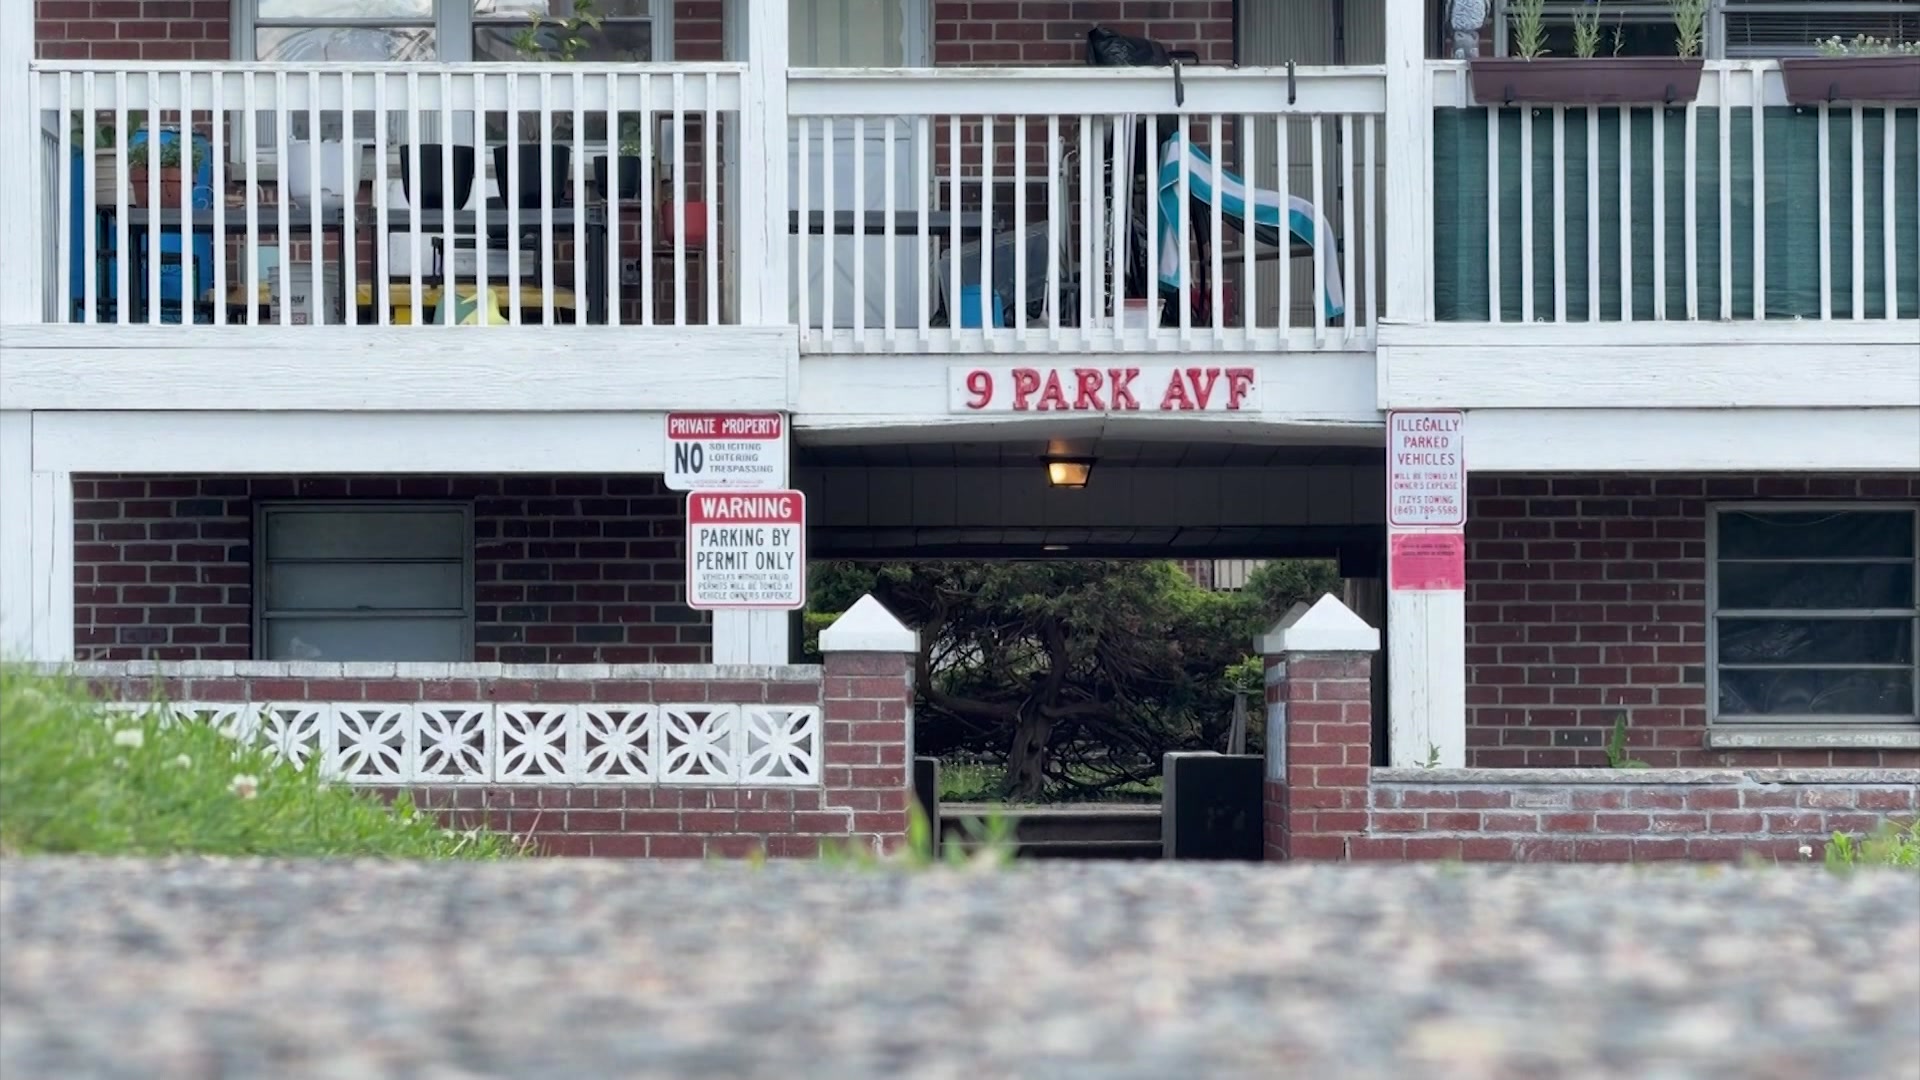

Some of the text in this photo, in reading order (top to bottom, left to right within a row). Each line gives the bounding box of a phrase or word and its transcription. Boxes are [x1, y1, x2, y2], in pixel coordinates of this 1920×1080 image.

[966, 370, 994, 410] 9
[1011, 368, 1140, 411] PARK
[670, 417, 779, 434] PRIVATE PROPERTY
[1396, 419, 1459, 432] ILLEGALLY
[709, 443, 761, 451] SOLICITING
[1403, 436, 1449, 448] PARKED
[675, 441, 703, 474] NO
[709, 453, 759, 462] LOITERING
[1397, 453, 1455, 465] VEHICLES
[709, 465, 773, 473] TRESPASSING
[1426, 481, 1458, 490] EXPENSE
[1424, 495, 1454, 504] TOWING
[700, 497, 792, 519] WARNING
[1394, 505, 1417, 515] (845)
[700, 528, 791, 547] PARKING BY
[696, 551, 794, 570] PERMIT ONLY
[702, 573, 789, 581] VEHICLES WITHOUT VALID
[698, 582, 793, 590] PERMITS WILL BE TOWED AT
[698, 591, 727, 600] VEHICLE
[761, 591, 793, 600] EXPENSE
